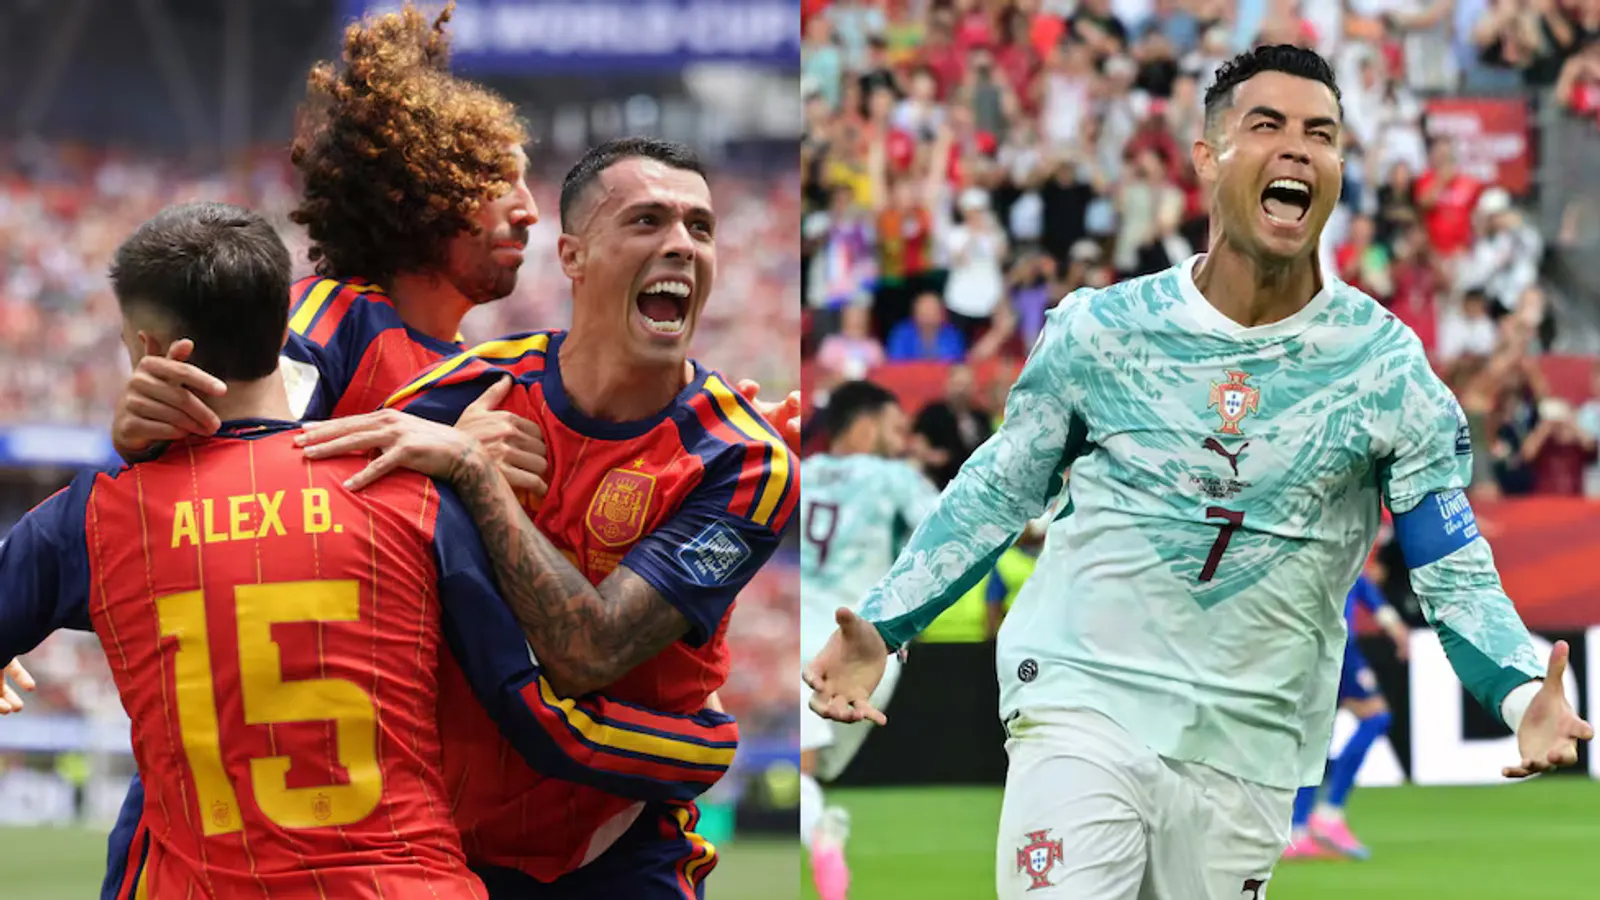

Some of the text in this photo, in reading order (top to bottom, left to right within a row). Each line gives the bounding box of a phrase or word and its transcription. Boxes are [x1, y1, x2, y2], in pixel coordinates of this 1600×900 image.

[170, 487, 344, 549] ALEX B.
[806, 501, 838, 566] 9
[1199, 506, 1246, 582] 7
[156, 579, 383, 837] 15
